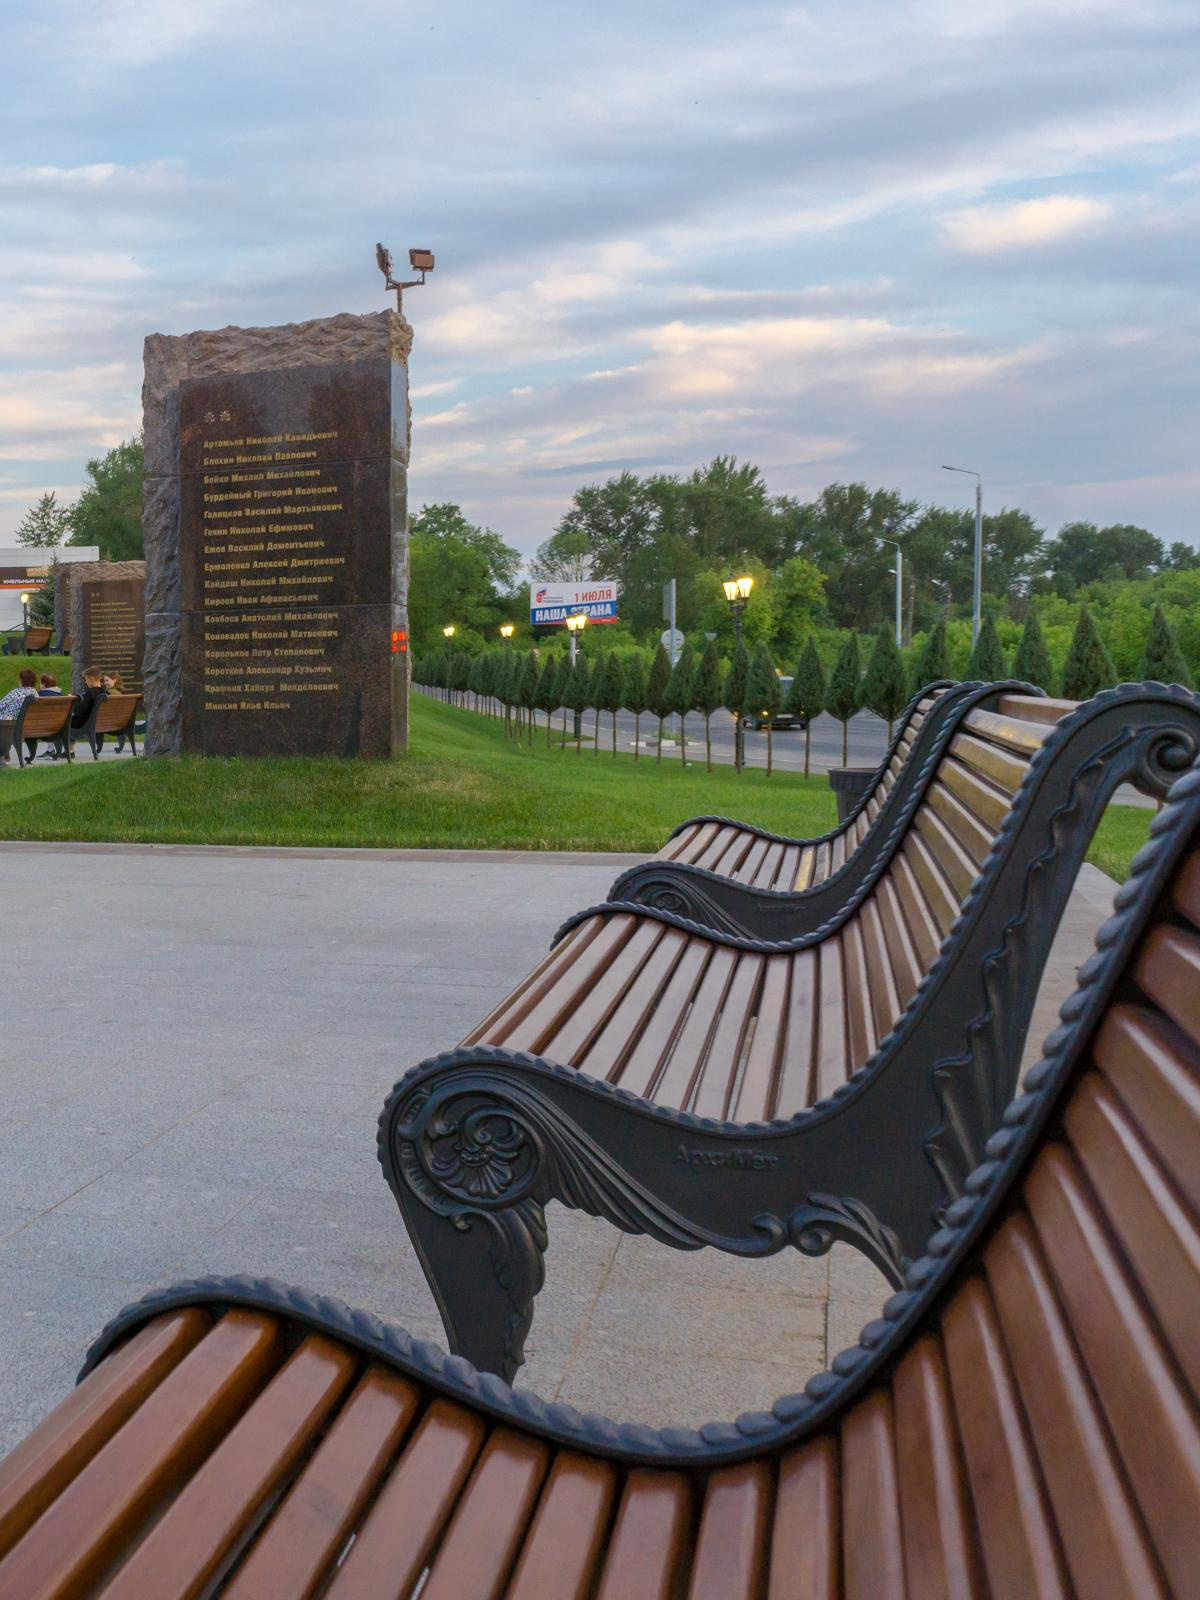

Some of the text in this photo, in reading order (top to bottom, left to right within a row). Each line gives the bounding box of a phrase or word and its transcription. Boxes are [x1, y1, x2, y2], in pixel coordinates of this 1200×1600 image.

[246, 434, 282, 445] Николай
[204, 450, 316, 466] Блохин Николай Павлович
[232, 472, 264, 482] Михаил
[267, 469, 320, 480] Михайлович
[204, 486, 338, 502] Бурдейный Григорий Иванович
[245, 507, 282, 516] Василий
[230, 525, 266, 535] Николай
[269, 523, 314, 534] Ефимович
[228, 542, 264, 552] Василий
[267, 540, 324, 551] Дементьевич
[253, 559, 288, 568] Алексей
[290, 557, 345, 568] Дмитриевич
[240, 577, 276, 586] Николай
[279, 575, 333, 585] Михайлович
[237, 596, 257, 604] Иван
[260, 594, 319, 604] Афанасьевич
[575, 593, 578, 602] 1
[582, 590, 612, 602] ИЮЛЯ
[241, 613, 282, 622] Анатолий
[284, 611, 339, 621] Михайлович
[536, 608, 566, 622] НАША
[205, 630, 338, 641] Коновалов Николай Матвеевич
[274, 648, 324, 656] Степанович
[246, 666, 292, 675] Александр
[295, 665, 332, 675] Кузьмич
